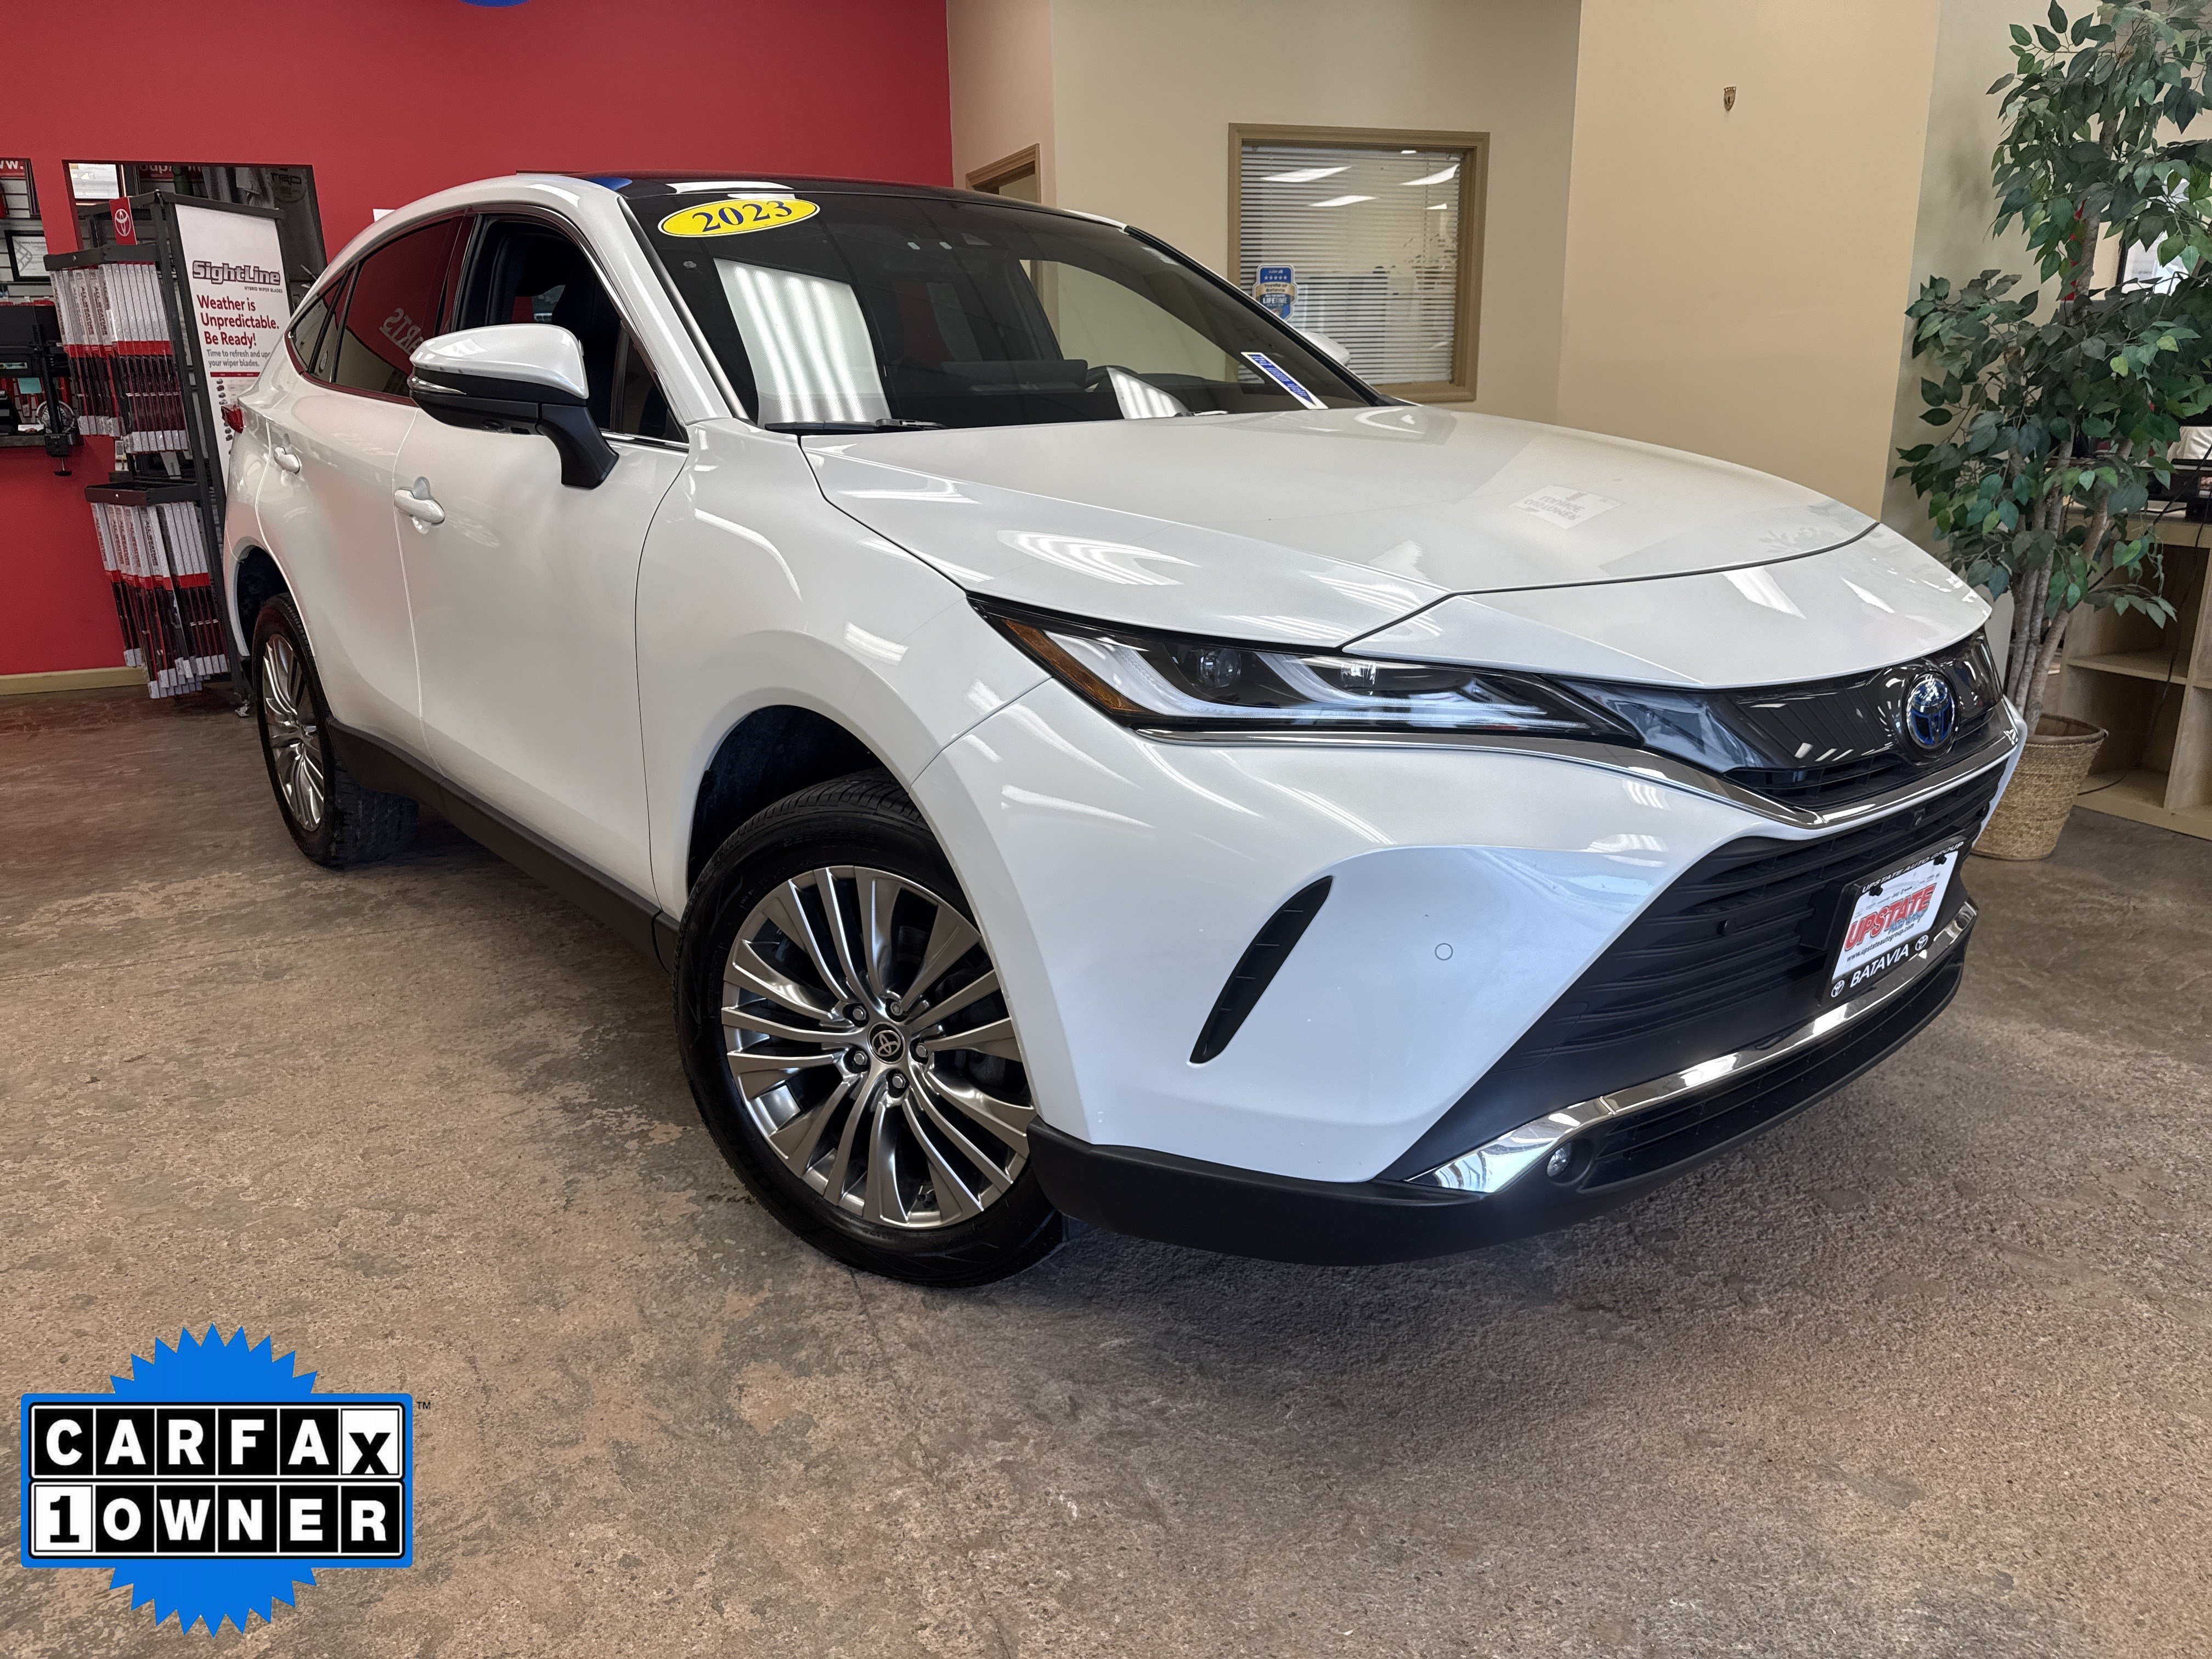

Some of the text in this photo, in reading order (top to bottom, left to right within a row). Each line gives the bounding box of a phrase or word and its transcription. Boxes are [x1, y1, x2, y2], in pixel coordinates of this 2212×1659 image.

[692, 200, 792, 232] 2023
[193, 260, 280, 285] SightLine
[81, 286, 94, 335] ALL-WEATHER
[94, 286, 108, 335] ALL-WEATHER
[196, 295, 256, 312] Weather is
[200, 312, 279, 330] Unpredictable.
[204, 331, 257, 349] Be Ready!
[206, 349, 221, 357] Time
[229, 349, 250, 358] refresh
[208, 358, 260, 368] your wiper blades.
[145, 520, 159, 566] ALL-WEATHER
[1862, 841, 1964, 893] UPSTATE AUTO GROUP
[1844, 882, 1937, 952] UPSTATE
[1847, 923, 1915, 962] www.upstateautogroup.com
[1849, 944, 1909, 988] BATAVIA
